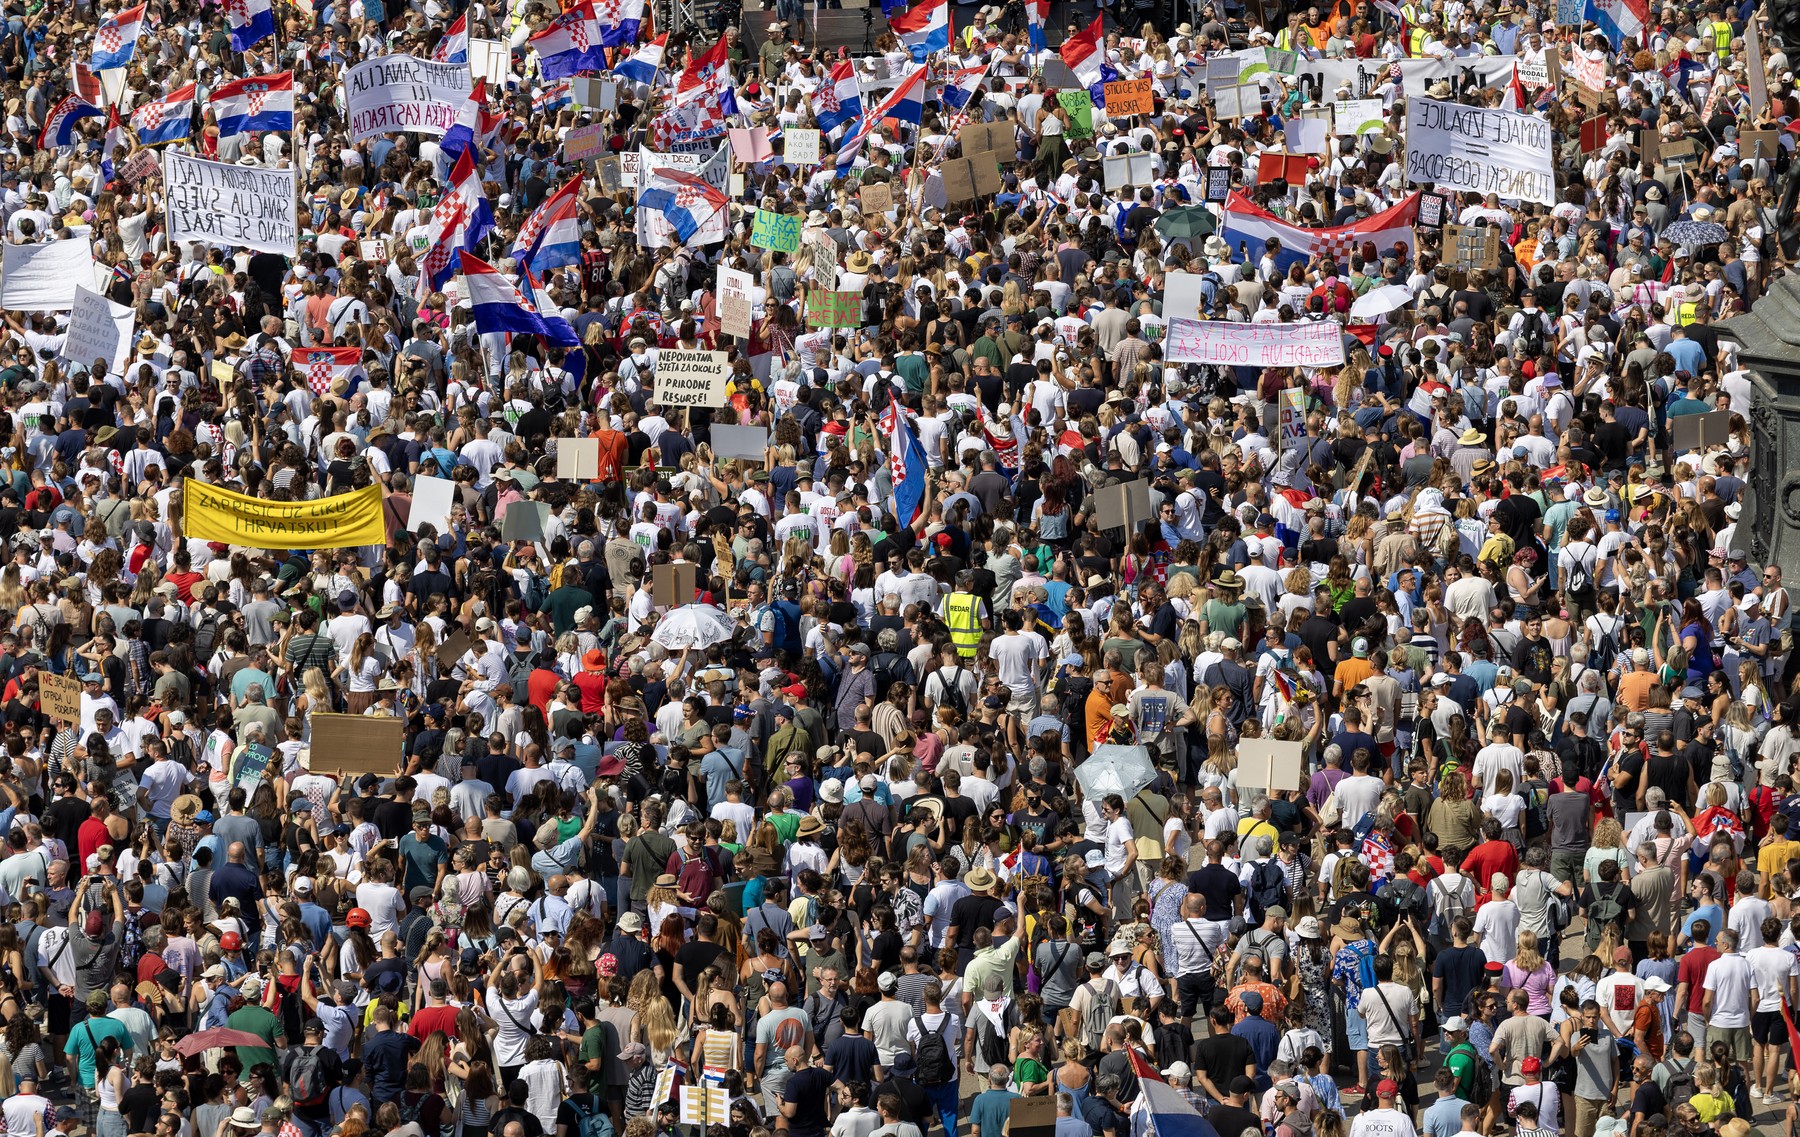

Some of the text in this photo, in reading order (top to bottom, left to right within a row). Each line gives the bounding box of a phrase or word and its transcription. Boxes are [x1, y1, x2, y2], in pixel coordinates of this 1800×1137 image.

[1134, 80, 1150, 92] VAS
[793, 132, 815, 140] KAD?
[792, 151, 814, 160] SAD?
[758, 211, 797, 230] LIKA
[764, 224, 797, 239] NEMA
[751, 232, 797, 252] REPRIZU
[812, 291, 860, 307] NEMA
[810, 308, 860, 324] PREDAJE
[659, 351, 713, 362] NEPOVRATNA
[658, 361, 679, 372] ŠTETA
[694, 364, 722, 374] OKOLIŠ
[666, 379, 711, 390] PRIRODNE
[663, 392, 707, 404] RESURSE!
[282, 506, 303, 518] UZ
[311, 501, 346, 517] LIKU
[245, 518, 326, 534] HRVATSKU
[950, 605, 970, 613] REDAR
[42, 674, 53, 686] NE
